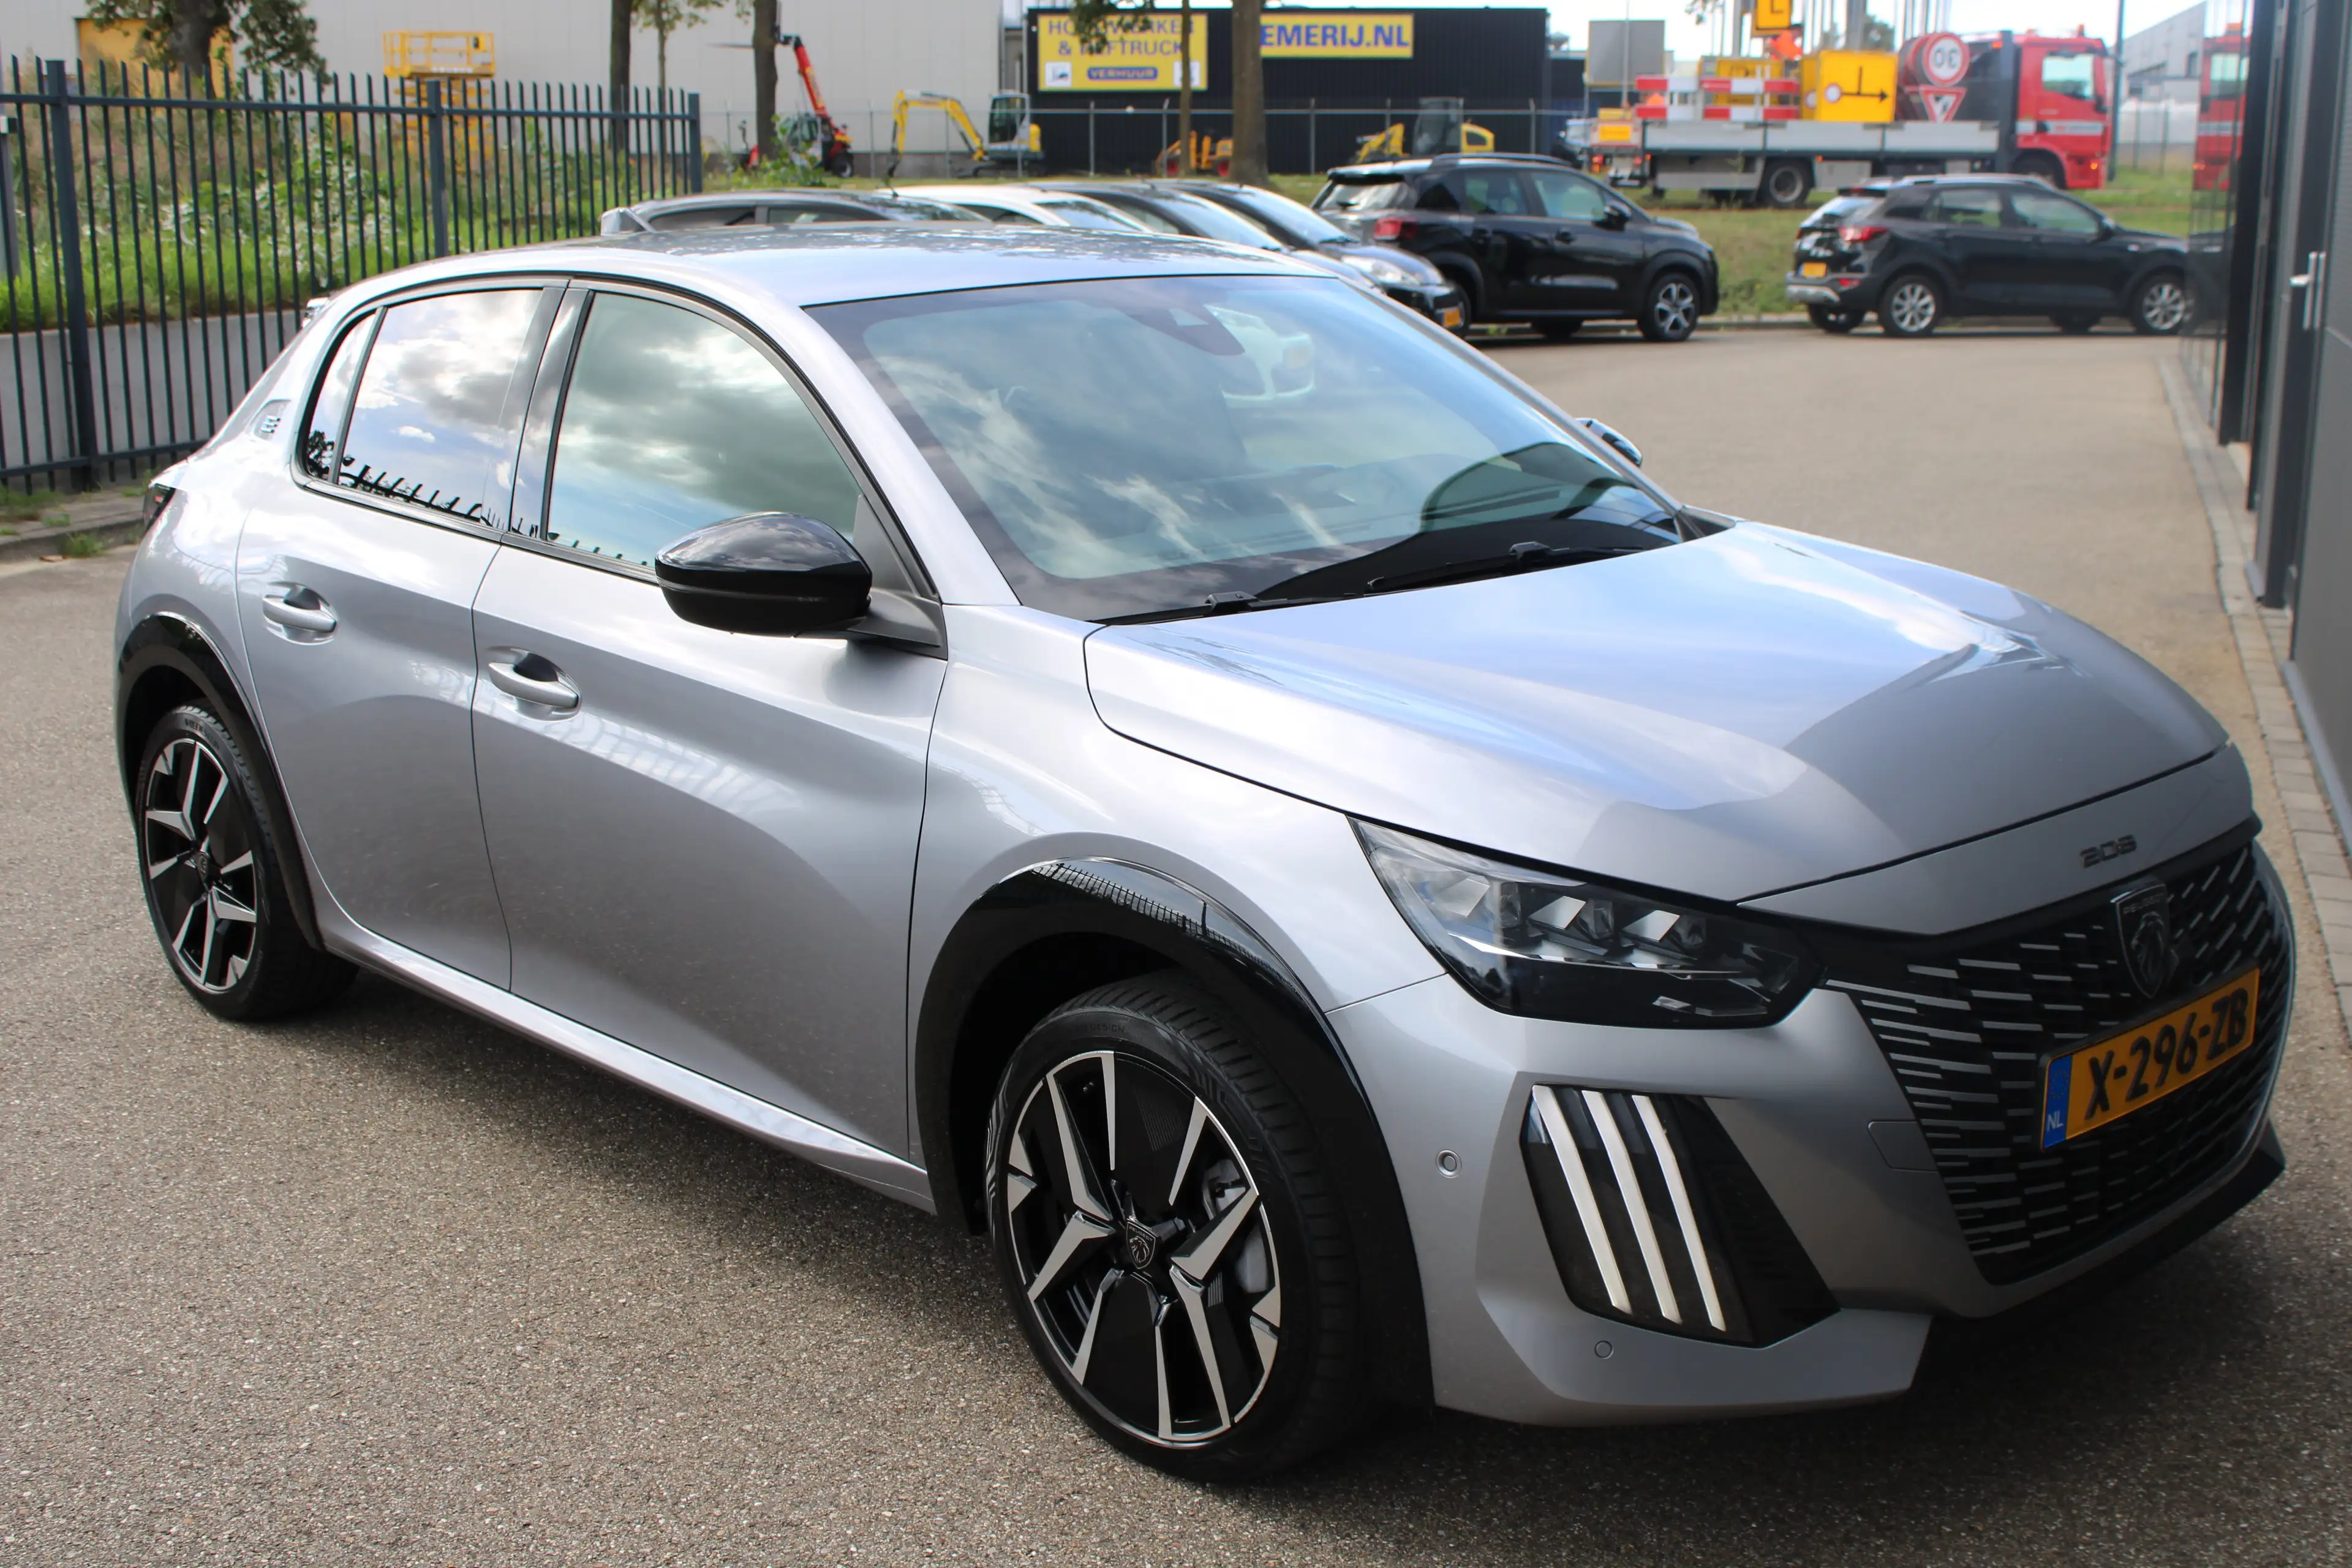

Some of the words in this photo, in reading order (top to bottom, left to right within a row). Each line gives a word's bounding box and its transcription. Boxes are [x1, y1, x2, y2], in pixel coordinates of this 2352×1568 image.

[1058, 39, 1071, 56] &
[2080, 834, 2137, 869] 208
[2084, 987, 2248, 1120] X-296-ZB
[2046, 1109, 2064, 1132] NL
[1129, 1225, 1153, 1242] PEUGEOT
